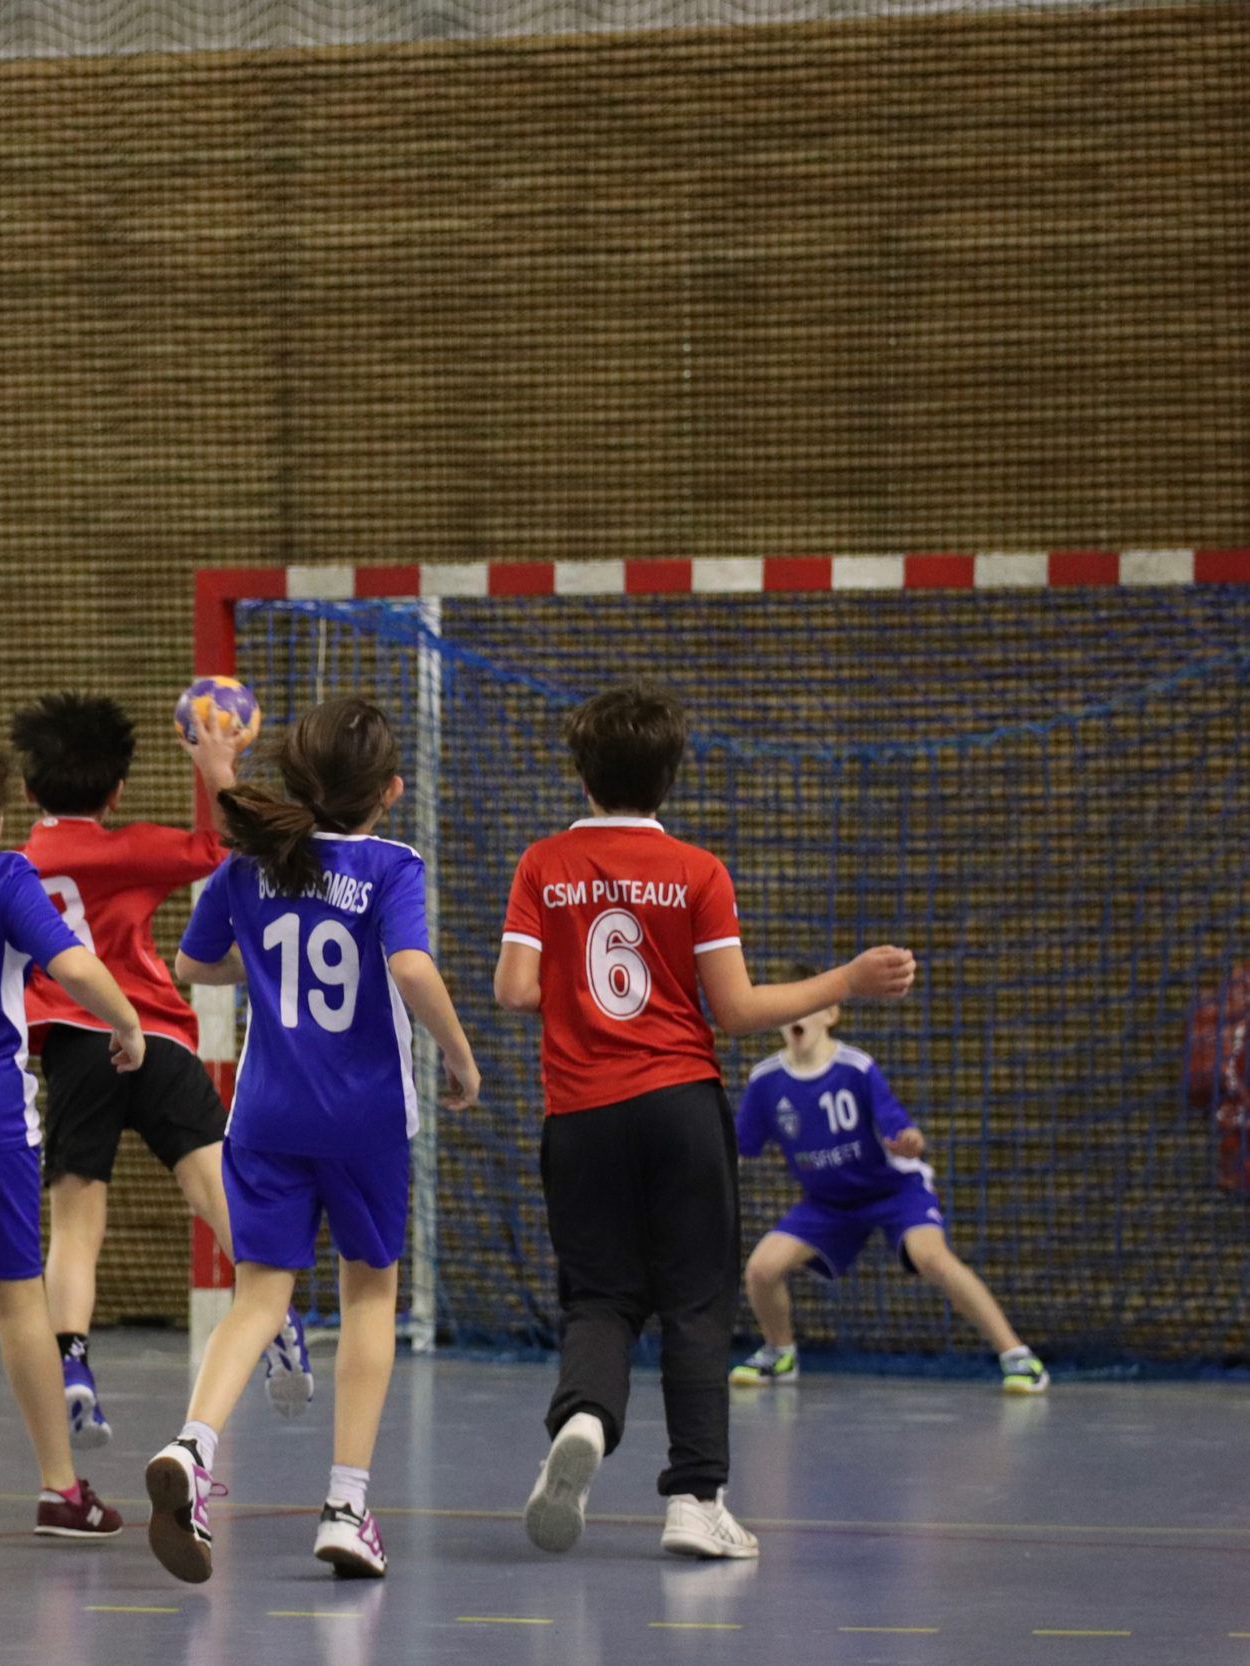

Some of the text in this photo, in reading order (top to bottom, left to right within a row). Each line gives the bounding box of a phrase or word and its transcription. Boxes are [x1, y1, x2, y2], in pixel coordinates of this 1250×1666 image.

[543, 879, 688, 909] CSM PUTEAUX
[263, 912, 360, 1033] 19
[586, 908, 651, 1021] 6
[818, 1088, 859, 1134] 10
